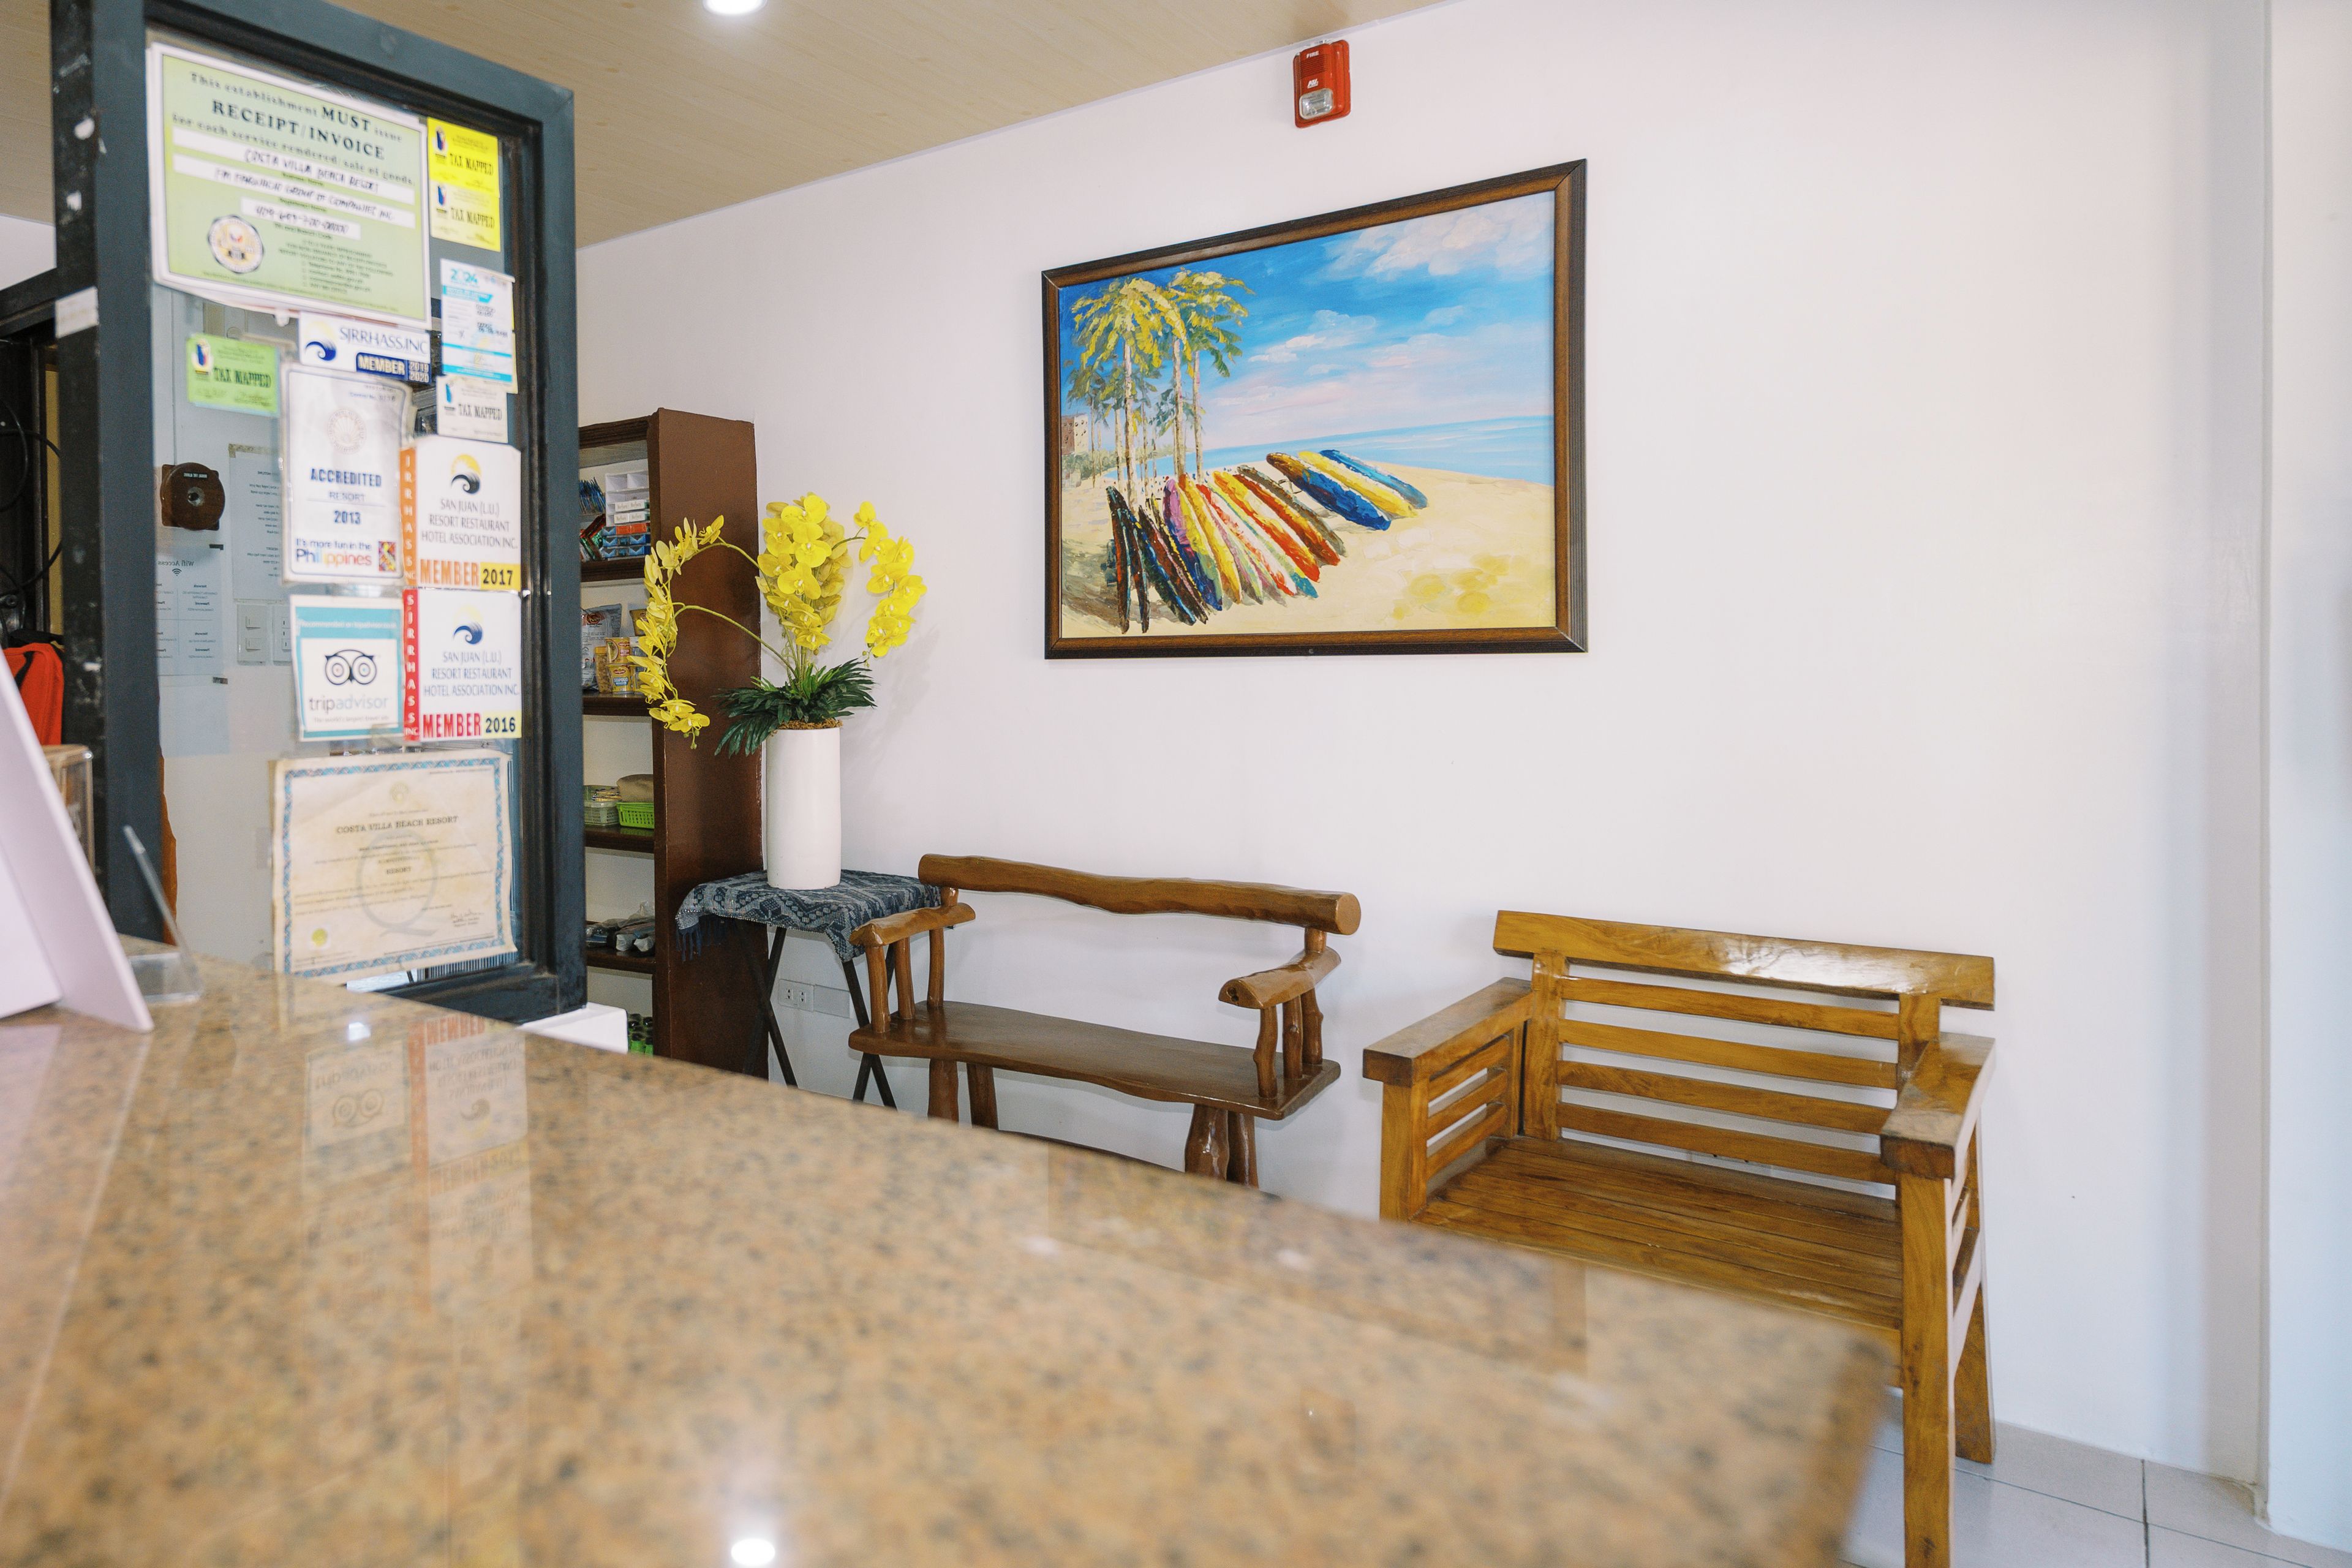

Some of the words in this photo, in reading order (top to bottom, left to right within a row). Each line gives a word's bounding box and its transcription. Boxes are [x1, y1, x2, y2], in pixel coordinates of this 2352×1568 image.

[323, 106, 371, 132] MUST
[212, 99, 300, 135] RECEIPT
[310, 126, 385, 160] INVOICE
[450, 153, 463, 168] TAX
[466, 157, 494, 176] MAPPED
[451, 206, 464, 221] TAX
[467, 211, 495, 229] MAPPED
[358, 353, 405, 375] MEMBER
[213, 367, 232, 383] TAX
[235, 369, 271, 388] MAPPED
[458, 404, 472, 417] TAX
[475, 405, 502, 421] MAPPED
[311, 468, 382, 488] ACCREDITED
[328, 491, 365, 502] RESORT
[440, 499, 456, 511] SAN
[458, 500, 478, 513] JUAN
[333, 510, 361, 525] 2013
[429, 514, 459, 527] RESORT
[461, 517, 510, 533] RESTAURANT
[310, 540, 331, 549] more
[334, 540, 349, 549] fun
[359, 541, 372, 550] the
[421, 531, 447, 543] HOTEL
[450, 533, 500, 548] ASSOCIATION
[296, 548, 372, 567] Philippines
[420, 559, 480, 587] MEMBER
[483, 568, 513, 586] 2017
[442, 651, 459, 663] SAN
[461, 651, 481, 665] JUAN
[432, 668, 461, 680] RESORT
[463, 667, 512, 680] RESTAURANT
[424, 685, 449, 697] HOTEL
[452, 684, 503, 697] ASSOCIATION
[309, 695, 388, 715] tripadvisor
[423, 712, 481, 738] MEMBER
[485, 716, 516, 733] 2016
[336, 824, 367, 834] COSTA
[369, 821, 393, 832] VILLA
[396, 820, 424, 829] BEACH
[427, 815, 459, 826] RESORT
[386, 865, 412, 875] RESORT
